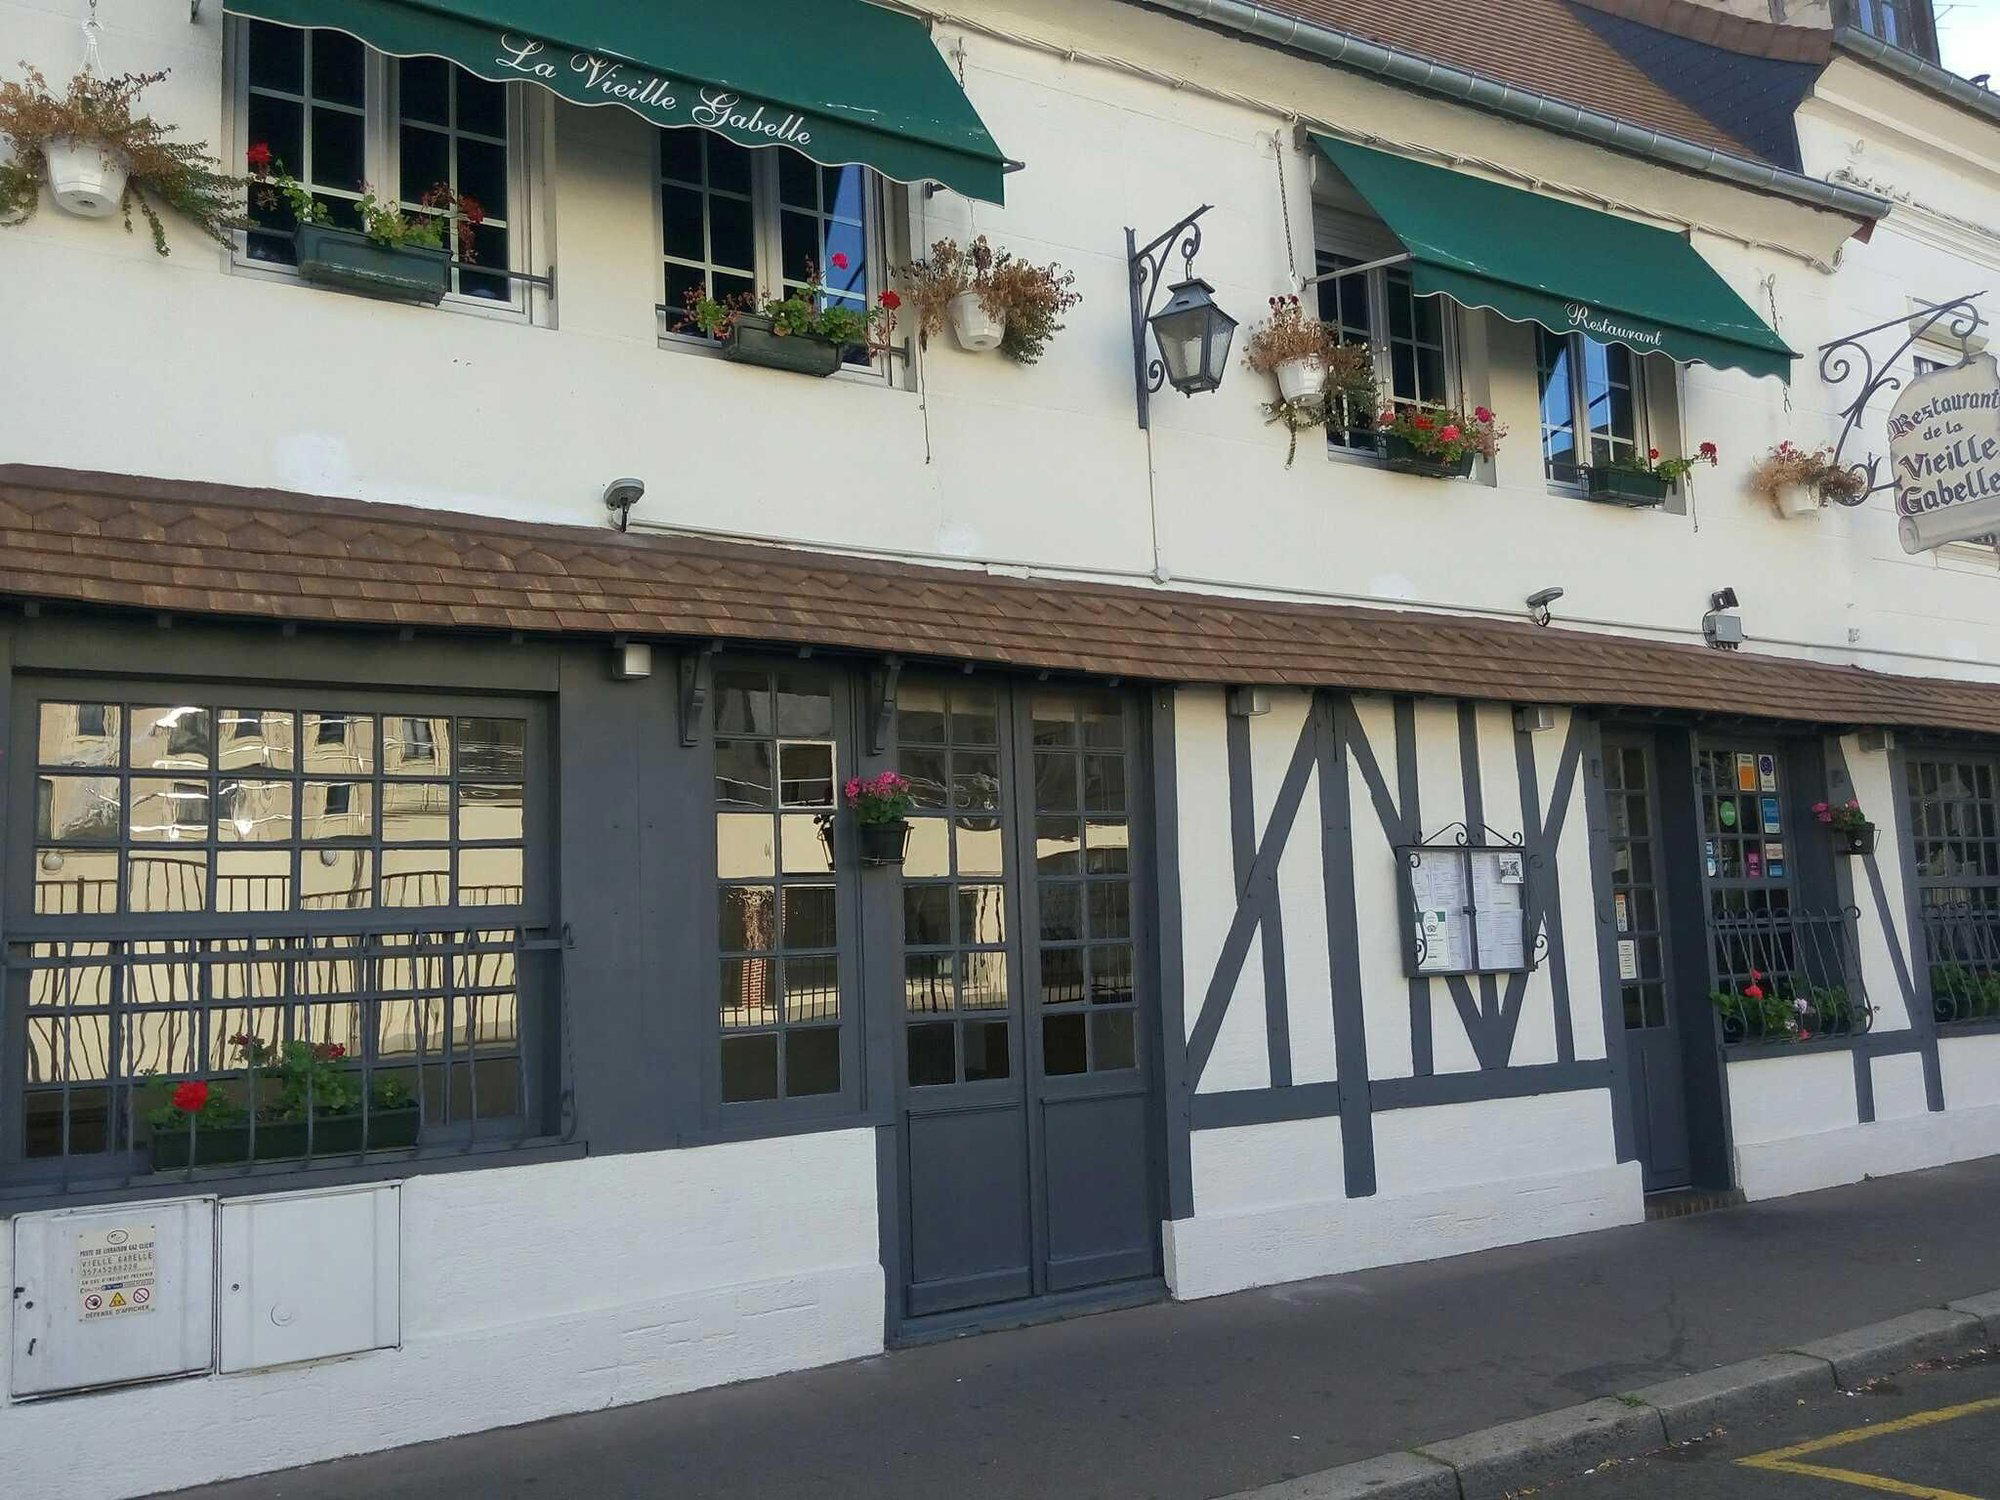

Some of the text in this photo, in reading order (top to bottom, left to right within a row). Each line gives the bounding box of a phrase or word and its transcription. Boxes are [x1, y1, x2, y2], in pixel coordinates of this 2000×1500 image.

[495, 31, 813, 146] La Vieille Gabelle
[1563, 302, 1662, 346] Restaurant
[1889, 389, 2000, 443] Restaurant
[1923, 420, 1963, 441] de la
[1898, 434, 2000, 481] Vieille
[1898, 466, 2000, 516] Gabelle
